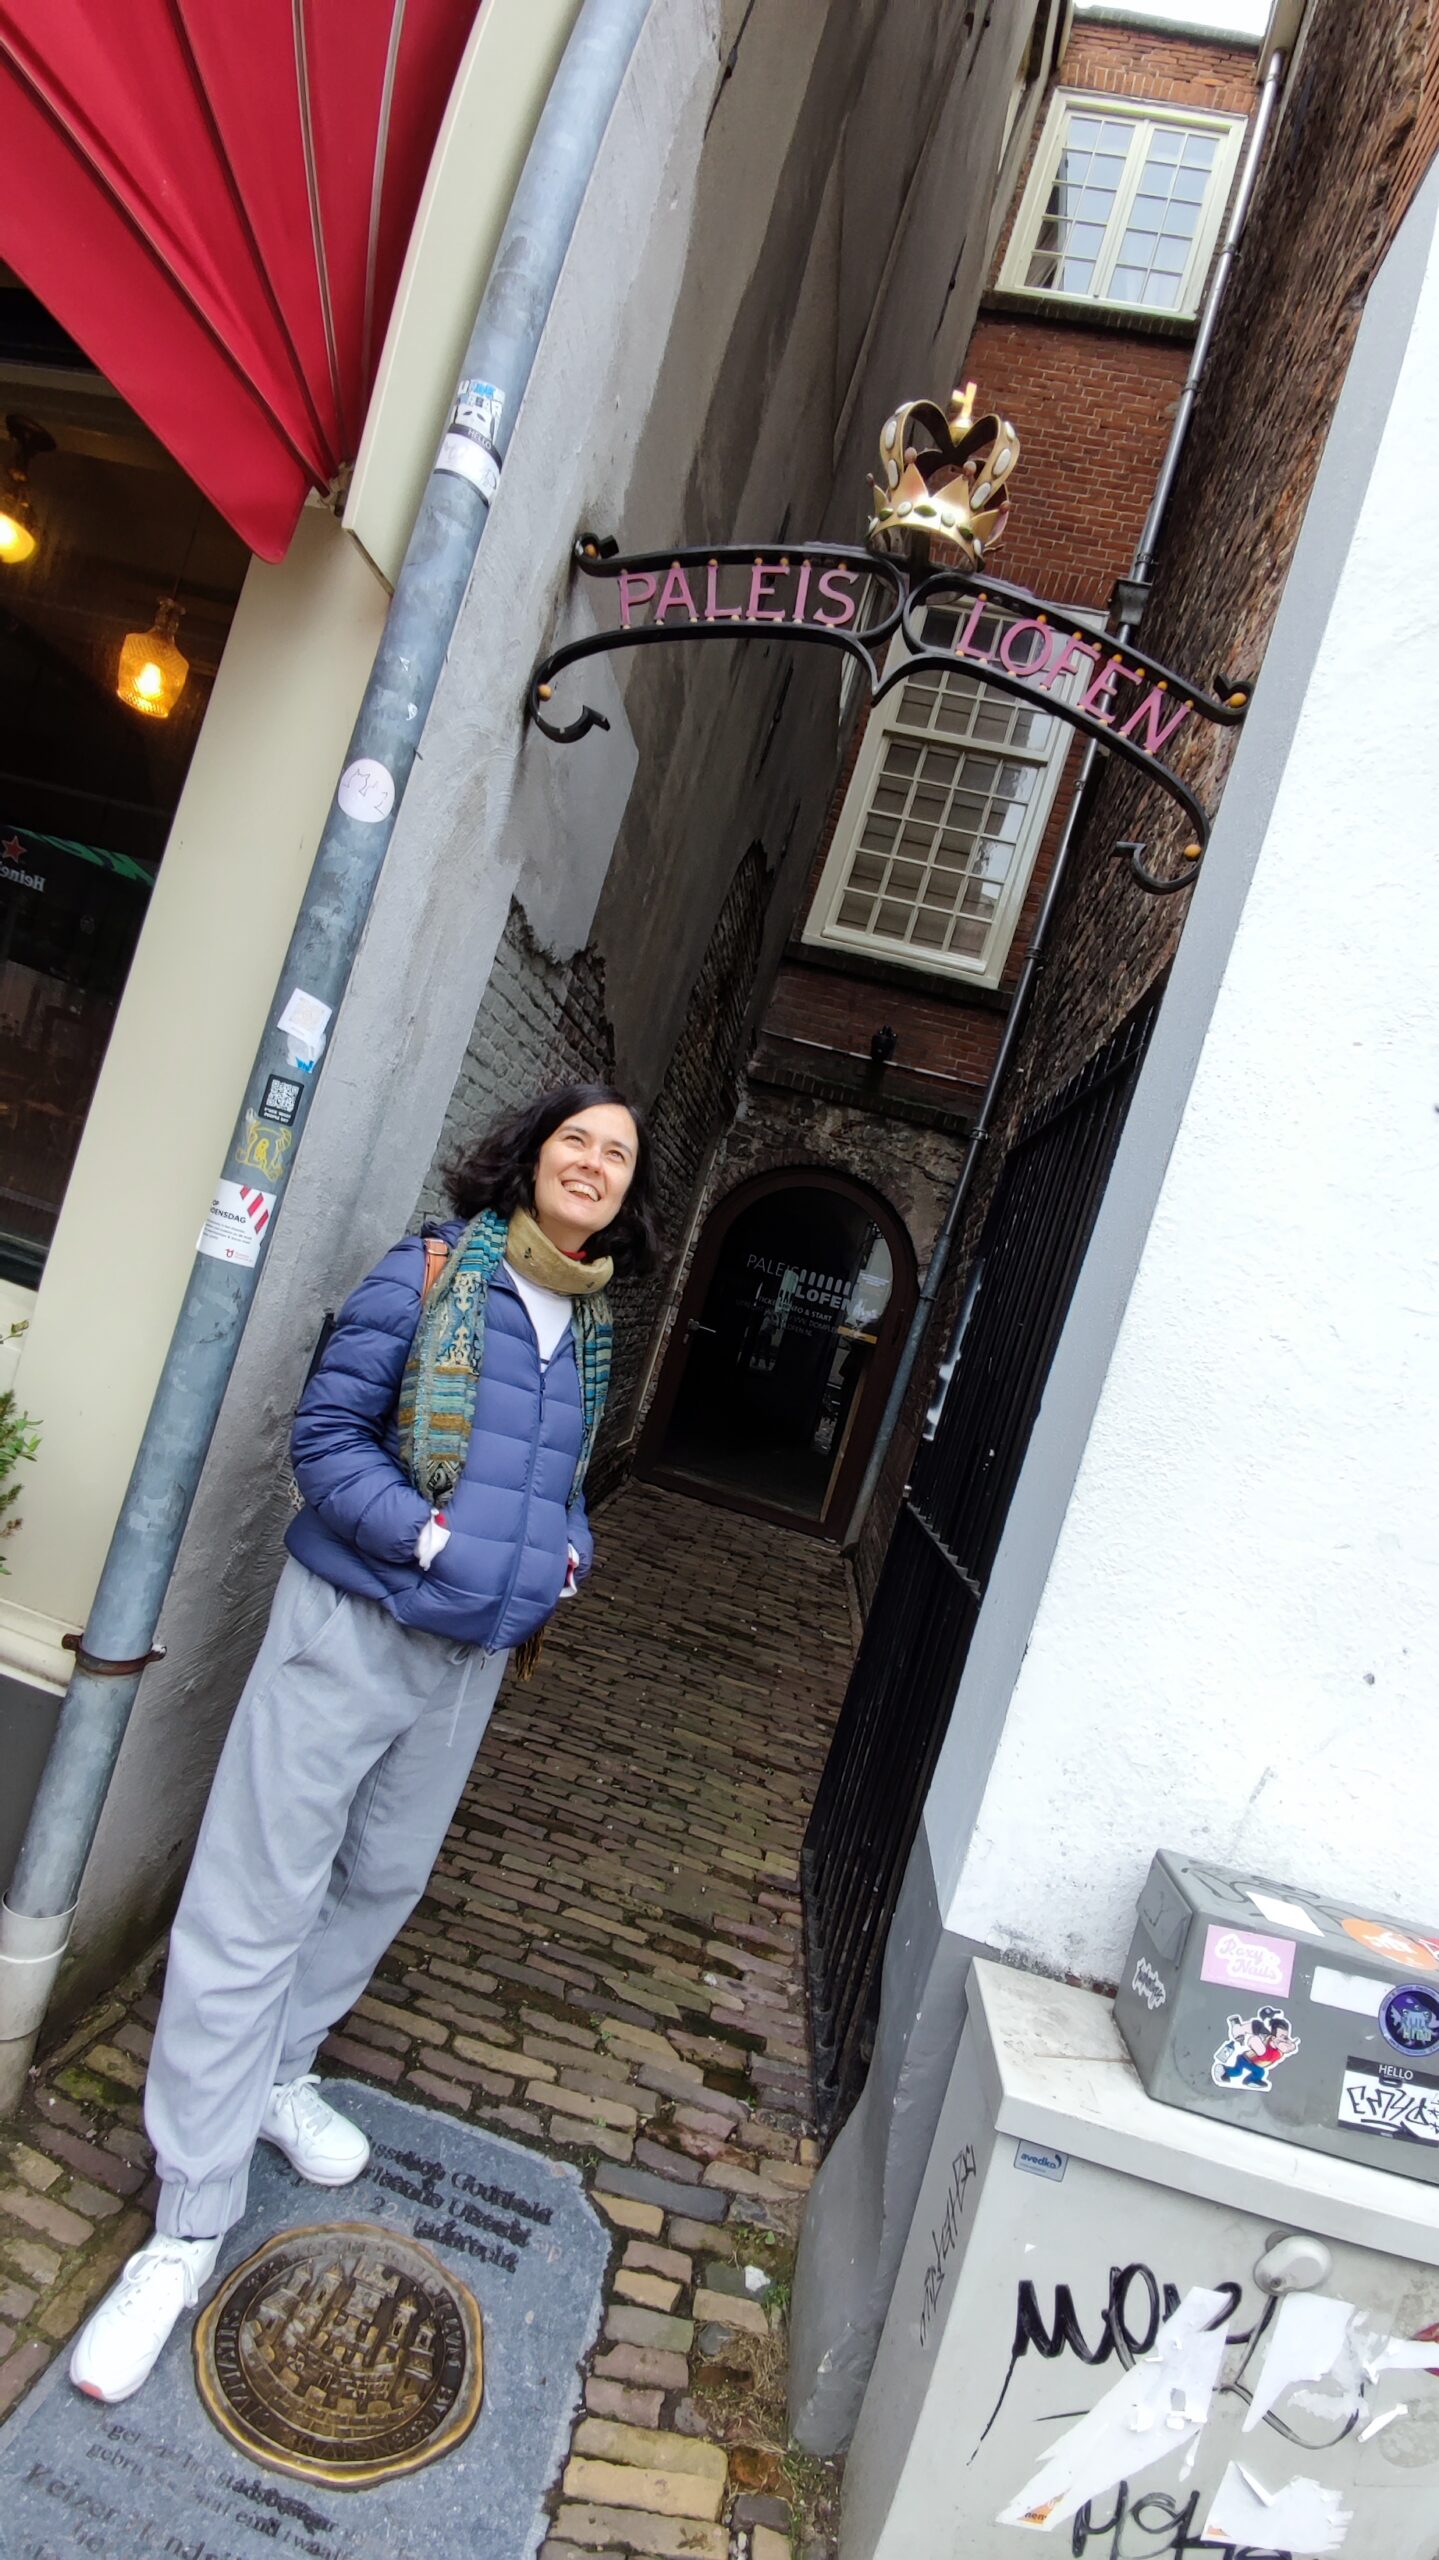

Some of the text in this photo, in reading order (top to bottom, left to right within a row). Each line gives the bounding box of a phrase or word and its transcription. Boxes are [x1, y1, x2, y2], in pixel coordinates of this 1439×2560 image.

[468, 427, 492, 450] HELLO
[618, 563, 1193, 753] PALEIS LOFEN
[210, 1206, 246, 1224] OENSDAG
[1378, 2063, 1414, 2081] HELLO
